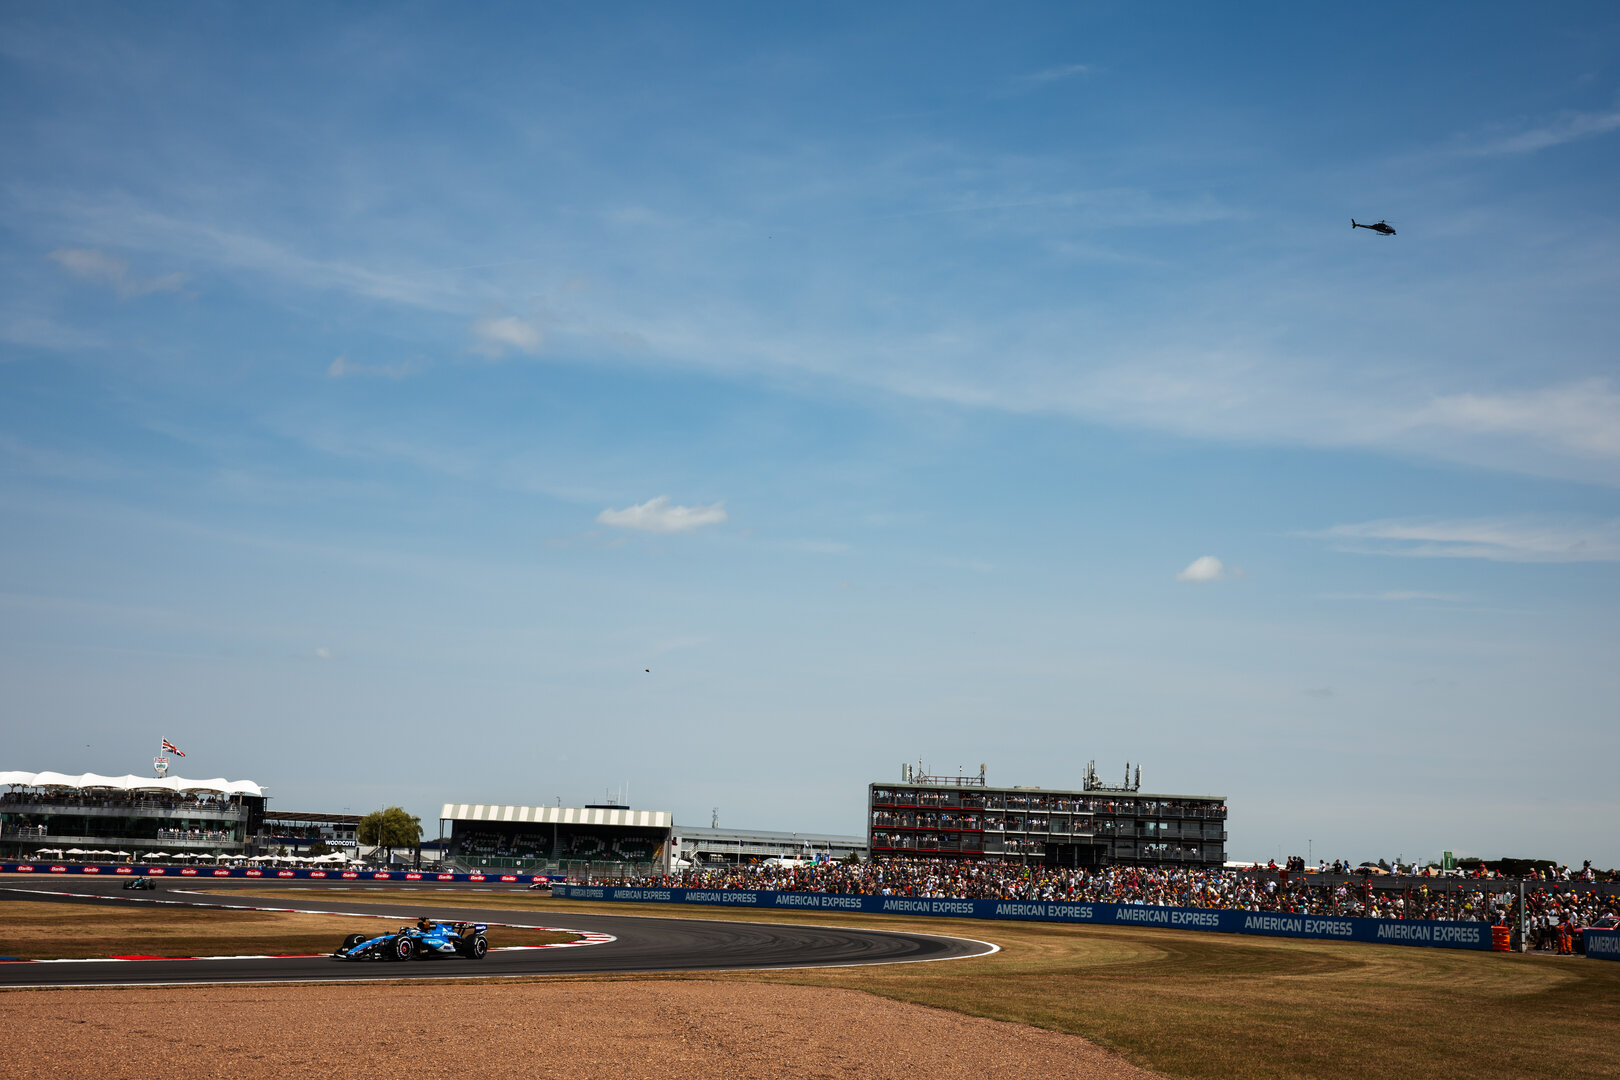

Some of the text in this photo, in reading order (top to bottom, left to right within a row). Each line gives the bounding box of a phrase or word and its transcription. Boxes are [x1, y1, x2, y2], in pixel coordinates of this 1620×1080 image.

[614, 890, 670, 900] AMERICAN EXPRESS
[686, 892, 756, 902] AMERICAN EXPRESS
[776, 895, 862, 908] AMERICAN EXPRESS
[883, 900, 974, 914] AMERICAN EXPRESS
[996, 904, 1092, 918] AMERICAN EXPRESS
[1116, 908, 1219, 926] AMERICAN EXPRESS
[1244, 916, 1352, 936] AMERICAN EXPRESS
[1377, 924, 1480, 942] AMERICAN EXPRESS
[1588, 936, 1620, 953] AMERICA
